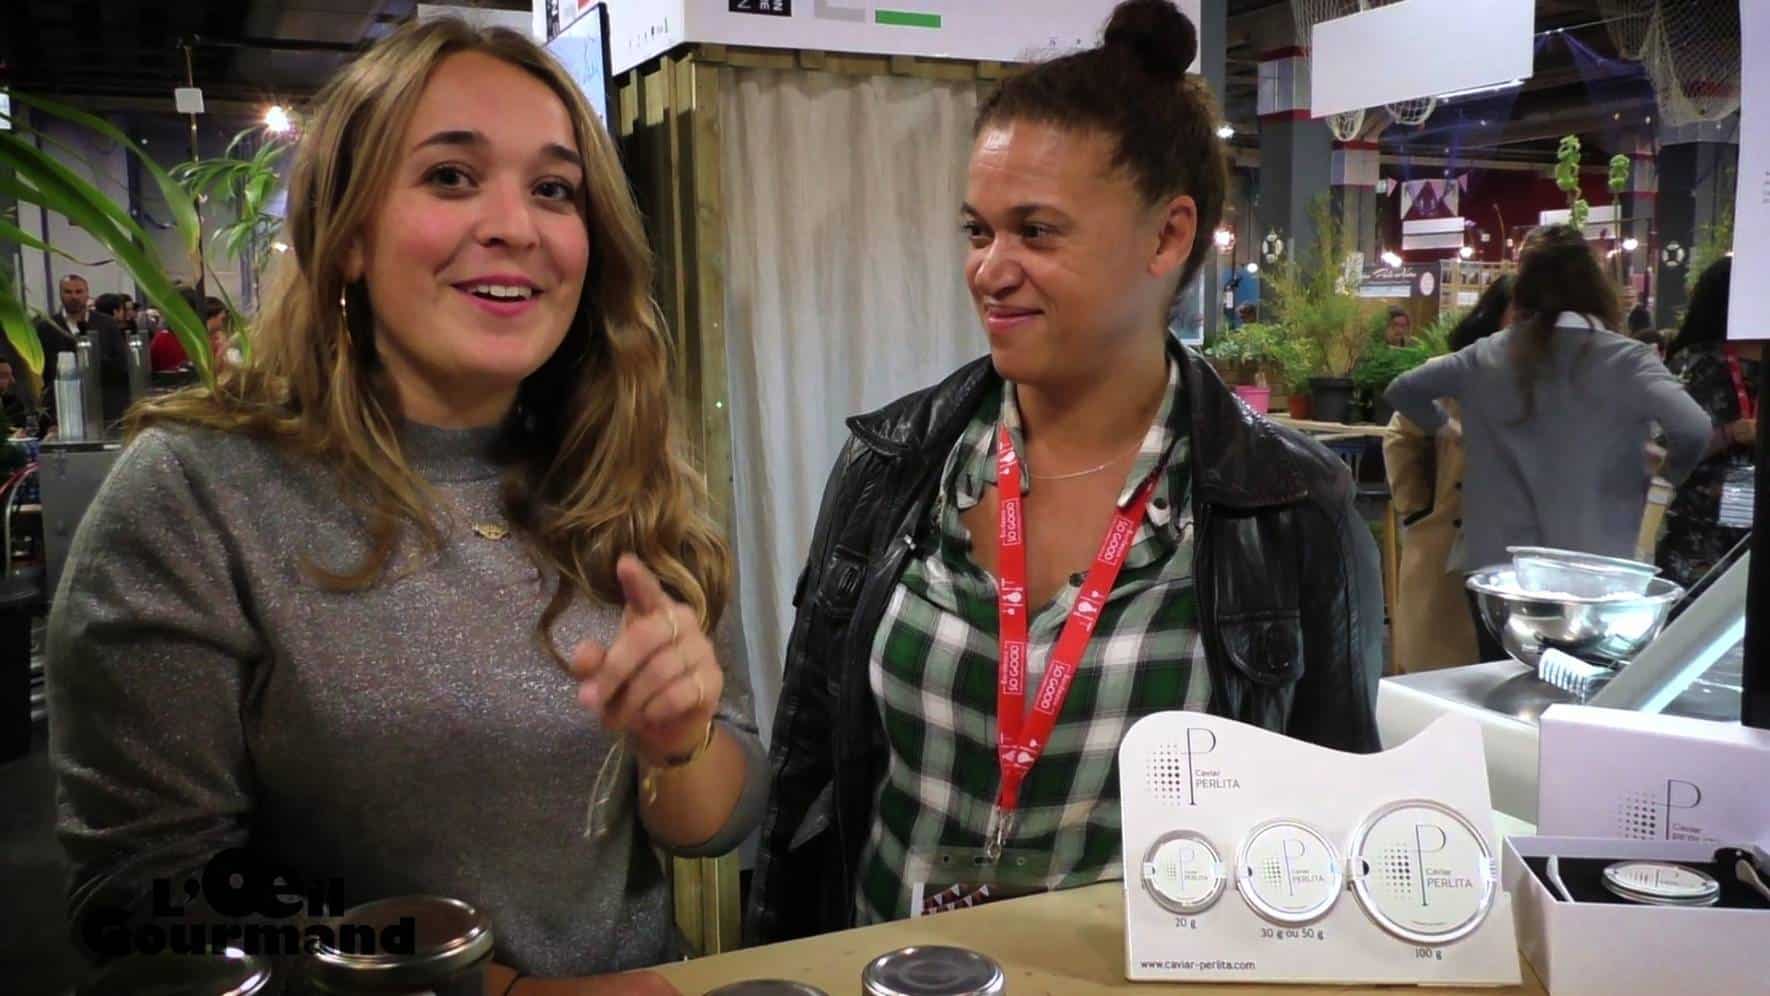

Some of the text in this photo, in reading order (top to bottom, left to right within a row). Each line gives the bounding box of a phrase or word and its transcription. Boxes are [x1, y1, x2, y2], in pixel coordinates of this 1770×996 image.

[1006, 502, 1016, 530] GOOD
[1104, 532, 1122, 561] GOOD
[1009, 645, 1020, 677] GOOD
[1040, 678, 1059, 709] GOOD
[1194, 769, 1221, 777] Caviar
[1195, 778, 1241, 789] PERLITA
[1425, 868, 1452, 876] Caviar
[1427, 877, 1473, 889] PERLITA
[1175, 917, 1197, 930] 20 g
[1261, 927, 1325, 941] 30 g ou 50 g
[1415, 947, 1443, 961] 100 g
[1139, 959, 1256, 971] www.caviar-perlita.com
